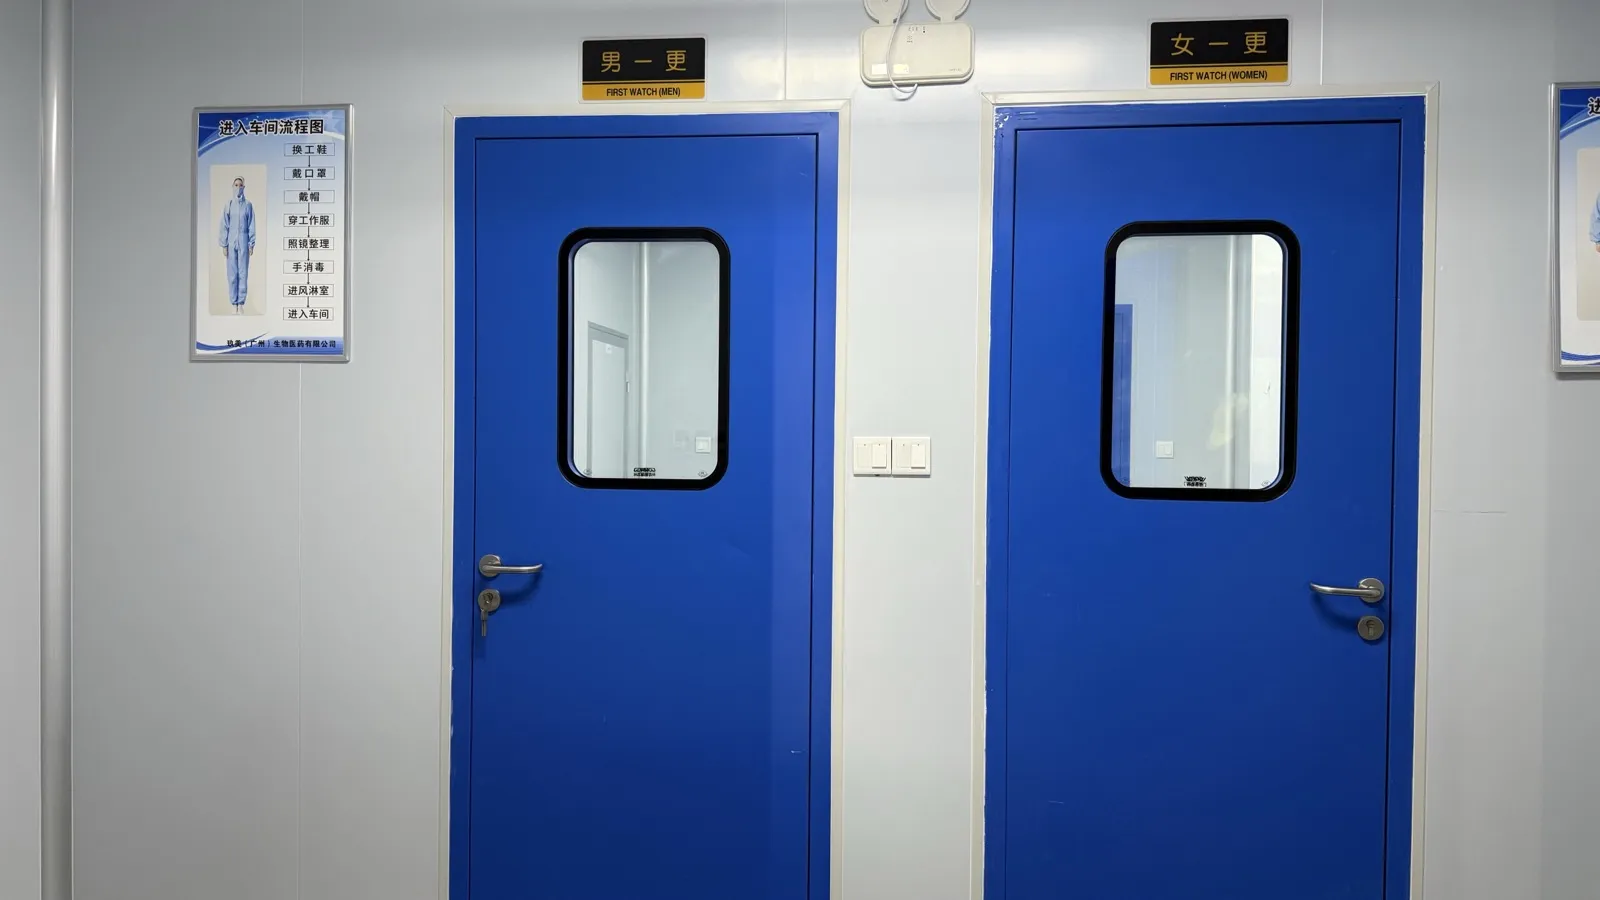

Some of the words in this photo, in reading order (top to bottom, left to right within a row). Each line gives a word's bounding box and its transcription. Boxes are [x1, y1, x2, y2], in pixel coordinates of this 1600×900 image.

[1170, 31, 1268, 56] 女一更
[600, 50, 687, 72] 男一更
[1169, 71, 1194, 81] FIRST
[1196, 70, 1227, 80] WATCH
[1228, 69, 1268, 81] (WOMEN)
[606, 88, 628, 97] FIRST
[629, 88, 657, 96] WATCH
[658, 87, 681, 97] (MEN)
[219, 119, 324, 135] 进入车间流程图
[292, 144, 327, 155] 换工鞋
[292, 168, 327, 179] 戴口罩
[299, 191, 320, 202] 戴帽
[288, 215, 330, 226] 穿工作服
[288, 238, 330, 249] 照镜整理
[292, 262, 325, 273] 手消毒
[288, 285, 329, 296] 进风淋室
[288, 308, 329, 319] 进入车间
